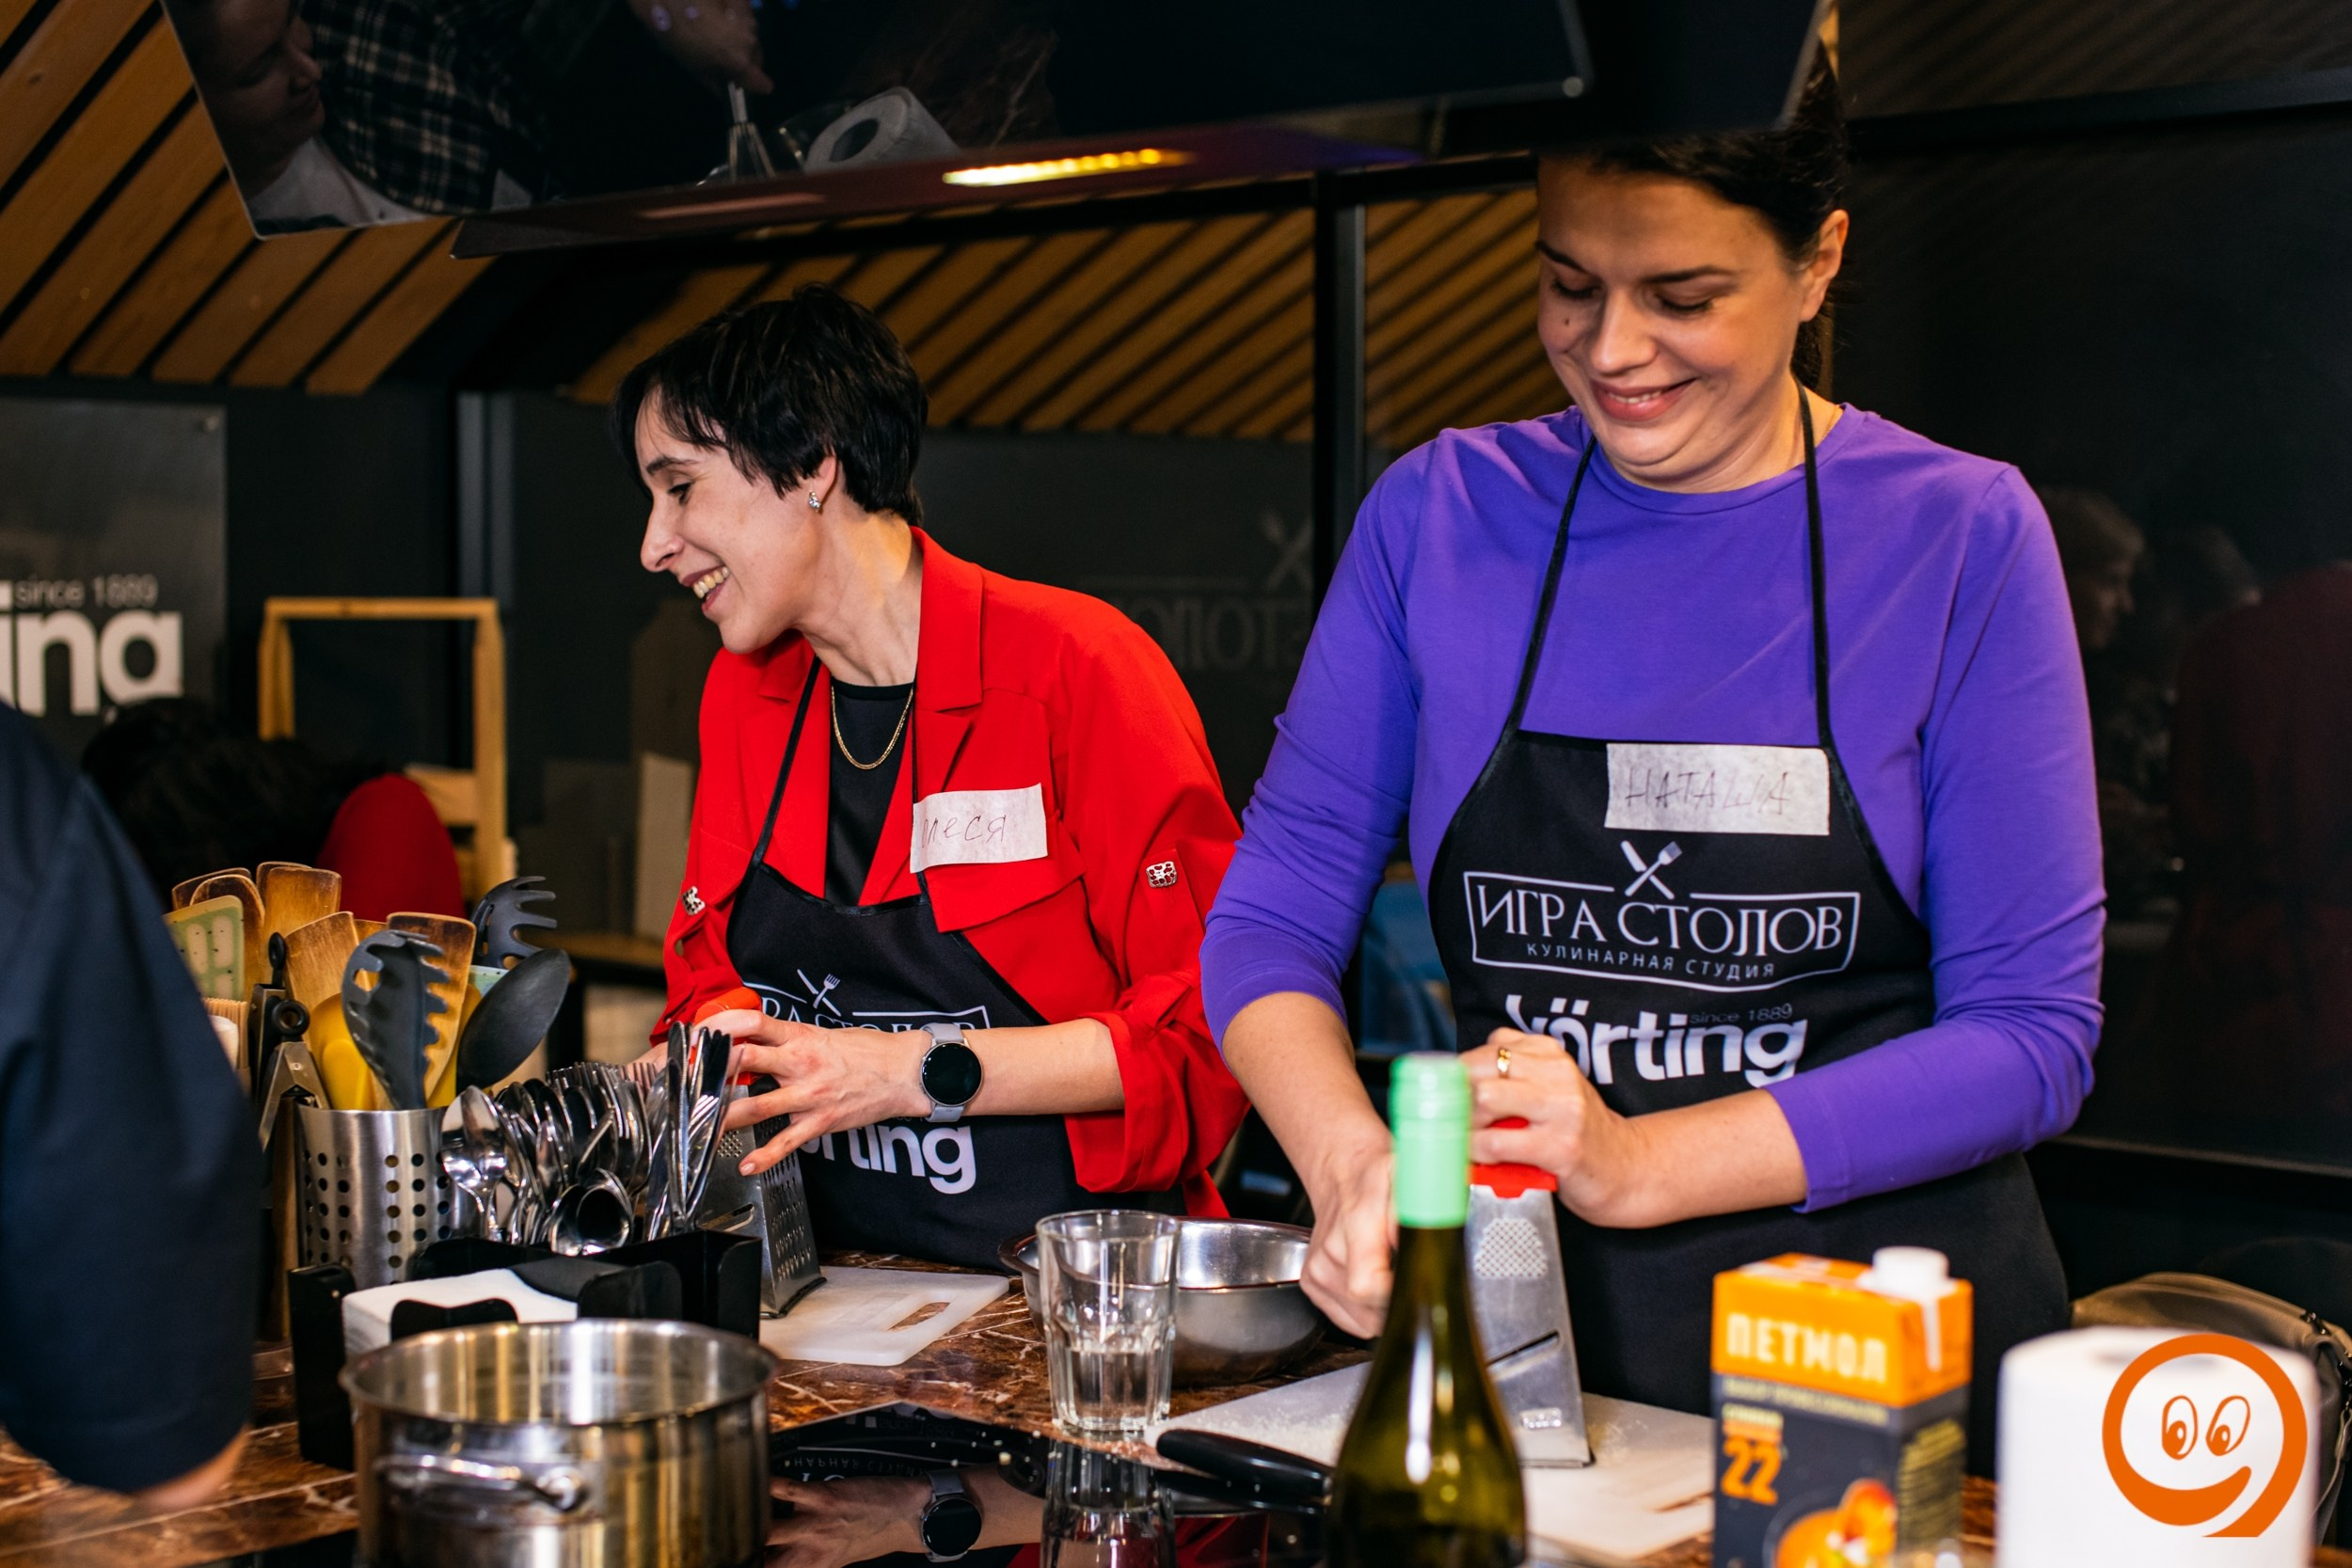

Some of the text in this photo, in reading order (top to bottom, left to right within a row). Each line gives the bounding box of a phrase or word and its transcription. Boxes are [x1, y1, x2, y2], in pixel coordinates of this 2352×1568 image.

[1625, 766, 1791, 816] НАТАША
[1477, 885, 1842, 957] ИГРА СТОЛОВ
[1527, 942, 1775, 981] КУЛИНАРНАЯ СТУДИЯ
[1690, 1002, 1793, 1023] since 1889
[1725, 1313, 1887, 1385] ПЕТМОЛ
[1721, 1433, 1782, 1505] 22
